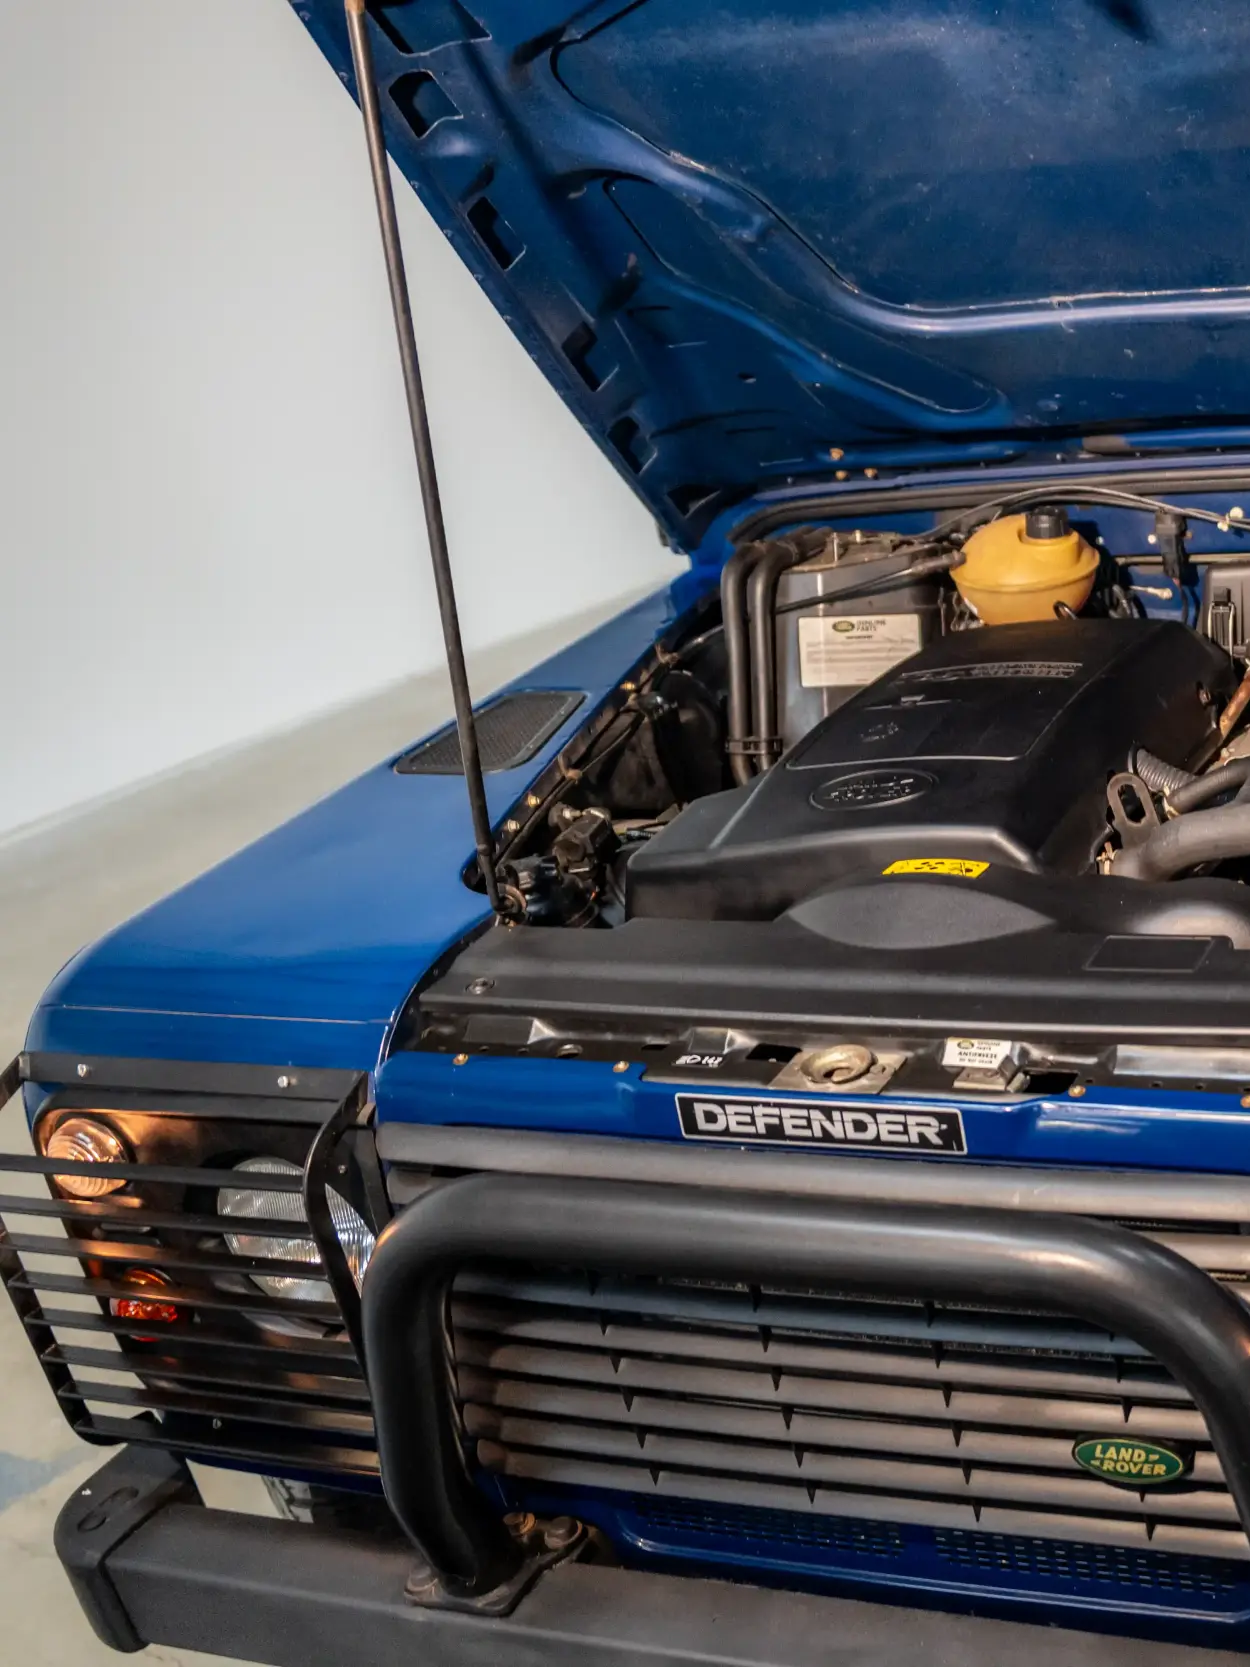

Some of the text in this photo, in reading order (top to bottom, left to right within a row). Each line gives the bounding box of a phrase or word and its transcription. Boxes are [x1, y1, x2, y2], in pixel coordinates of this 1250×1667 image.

[693, 1102, 944, 1145] DEFENDER
[1095, 1444, 1146, 1463] LAND
[1102, 1459, 1167, 1476] ROVER
